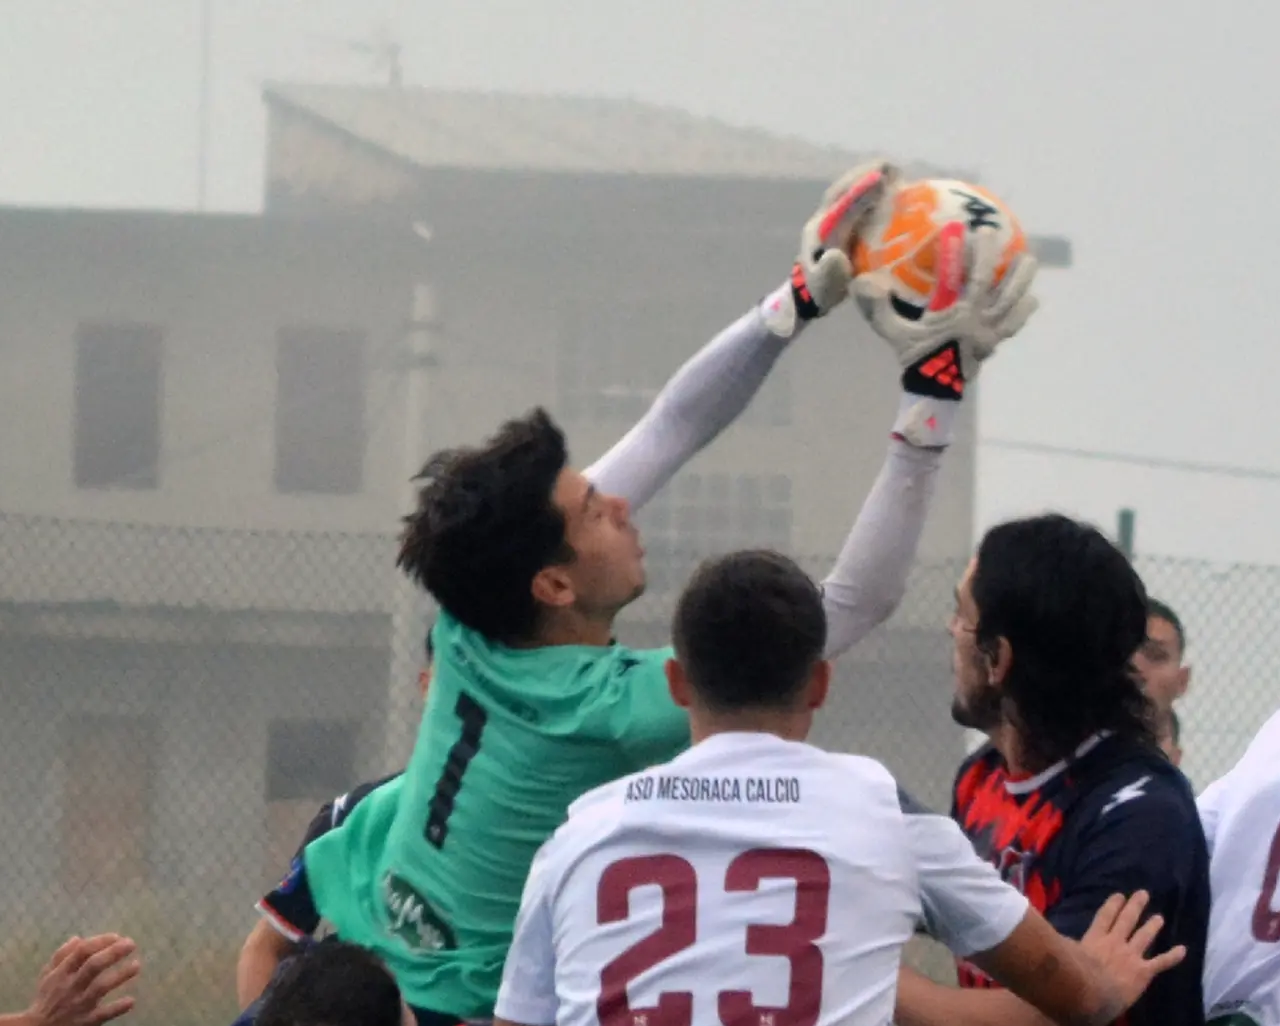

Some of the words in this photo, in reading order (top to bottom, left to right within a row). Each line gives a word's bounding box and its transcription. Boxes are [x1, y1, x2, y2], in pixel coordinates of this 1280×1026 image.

[424, 691, 486, 850] 1
[626, 776, 654, 803] ASD
[656, 775, 741, 803] MESORACA
[745, 776, 800, 803] CALCIO
